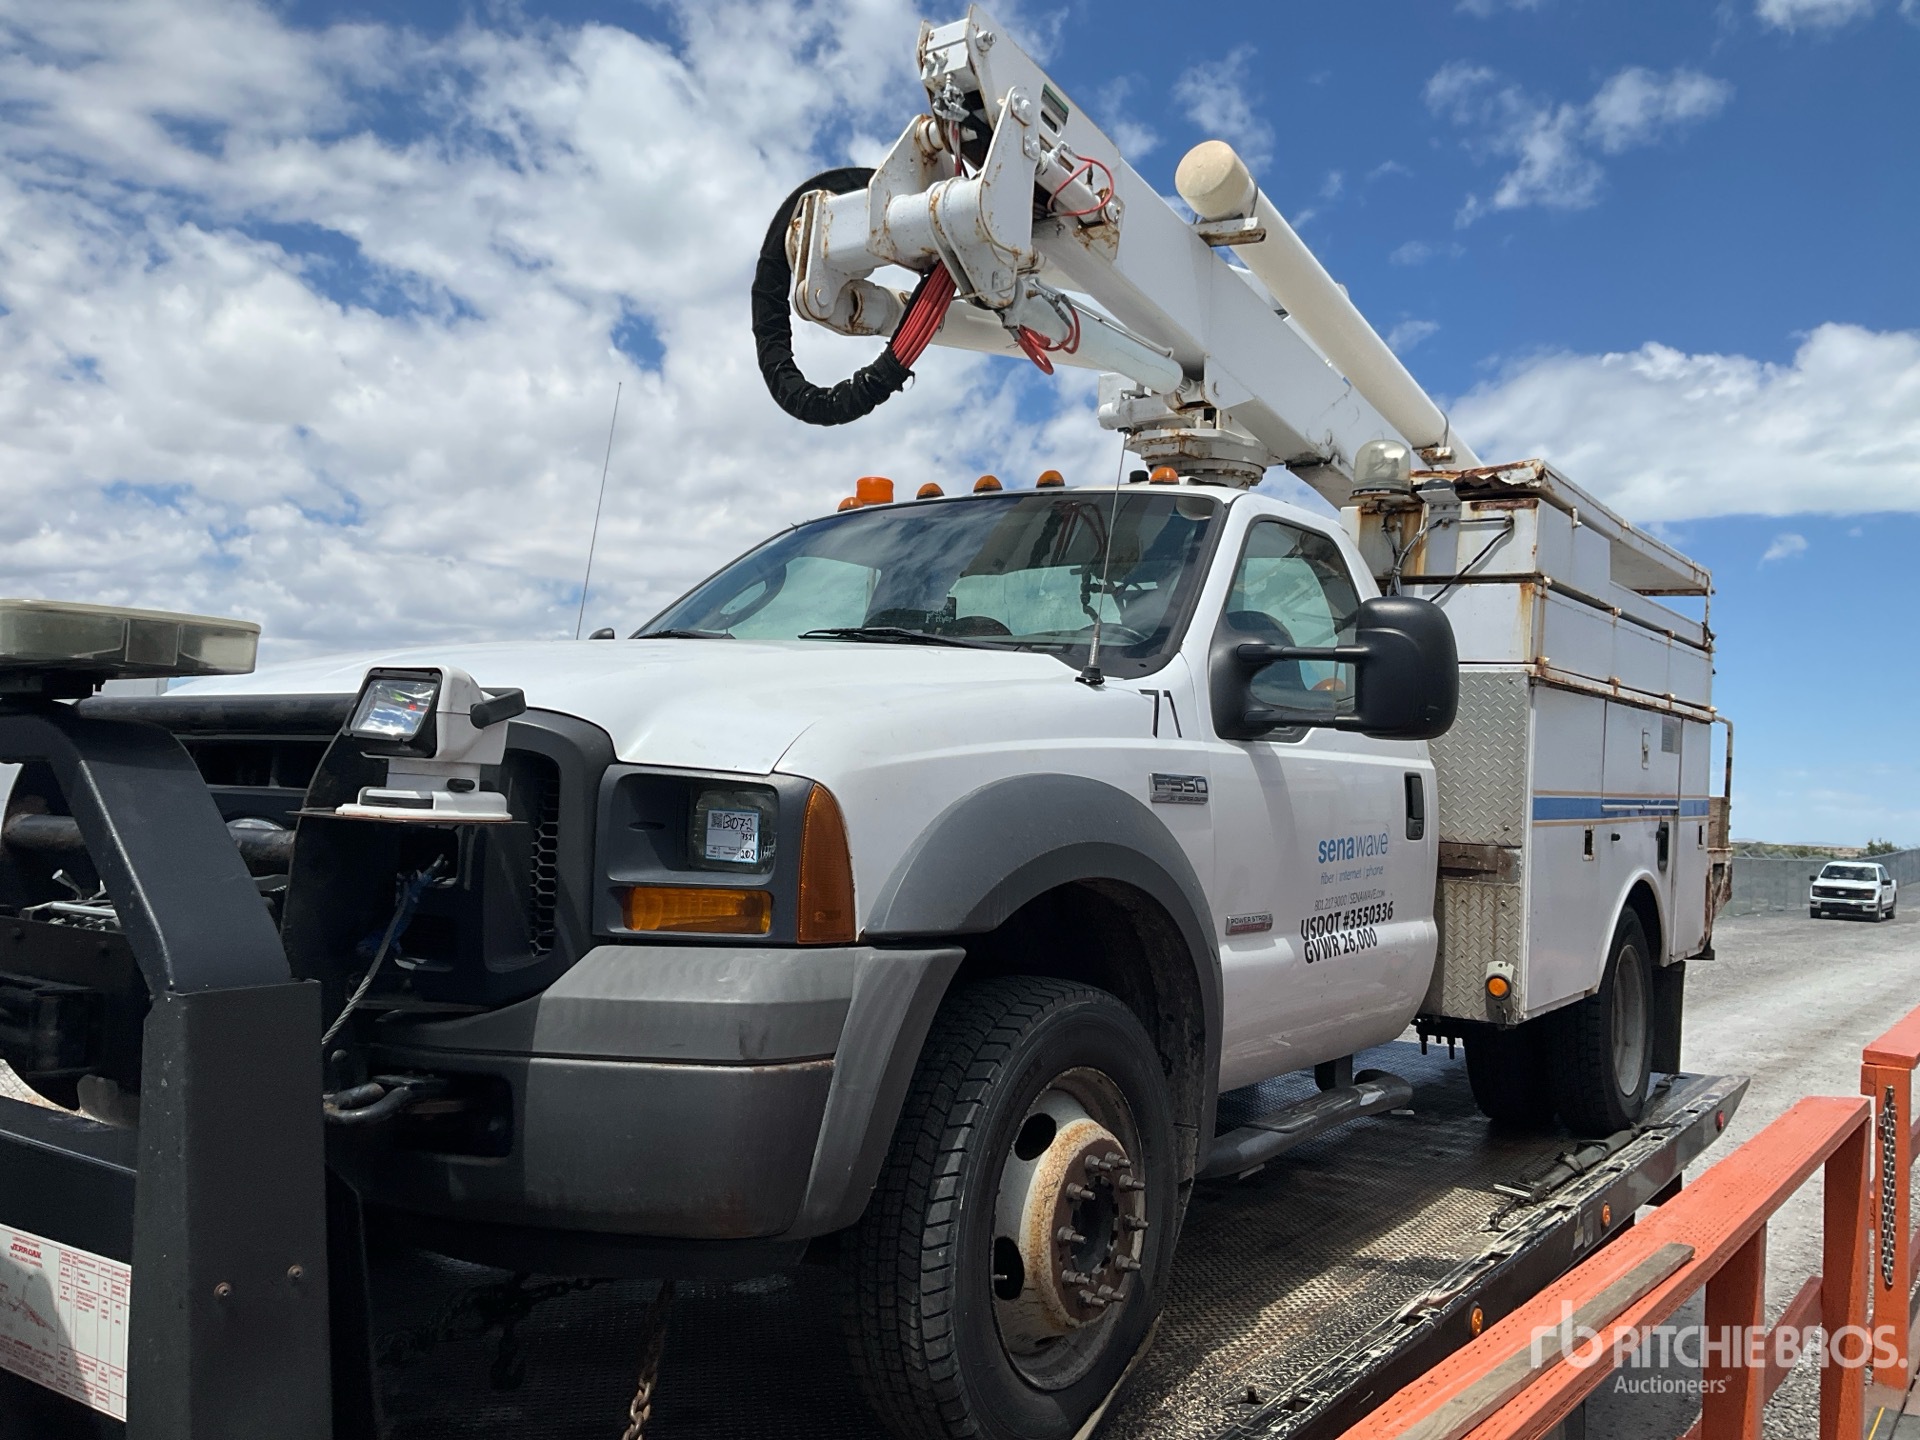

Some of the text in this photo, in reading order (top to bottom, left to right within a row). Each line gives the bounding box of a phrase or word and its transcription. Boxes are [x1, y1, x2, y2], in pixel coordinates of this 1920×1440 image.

[1317, 832, 1389, 864] senawave
[1320, 871, 1335, 885] fiber
[1366, 864, 1384, 880] phone
[1300, 900, 1394, 942] USDOT #3550336
[1304, 926, 1378, 964] GVWR 26,000
